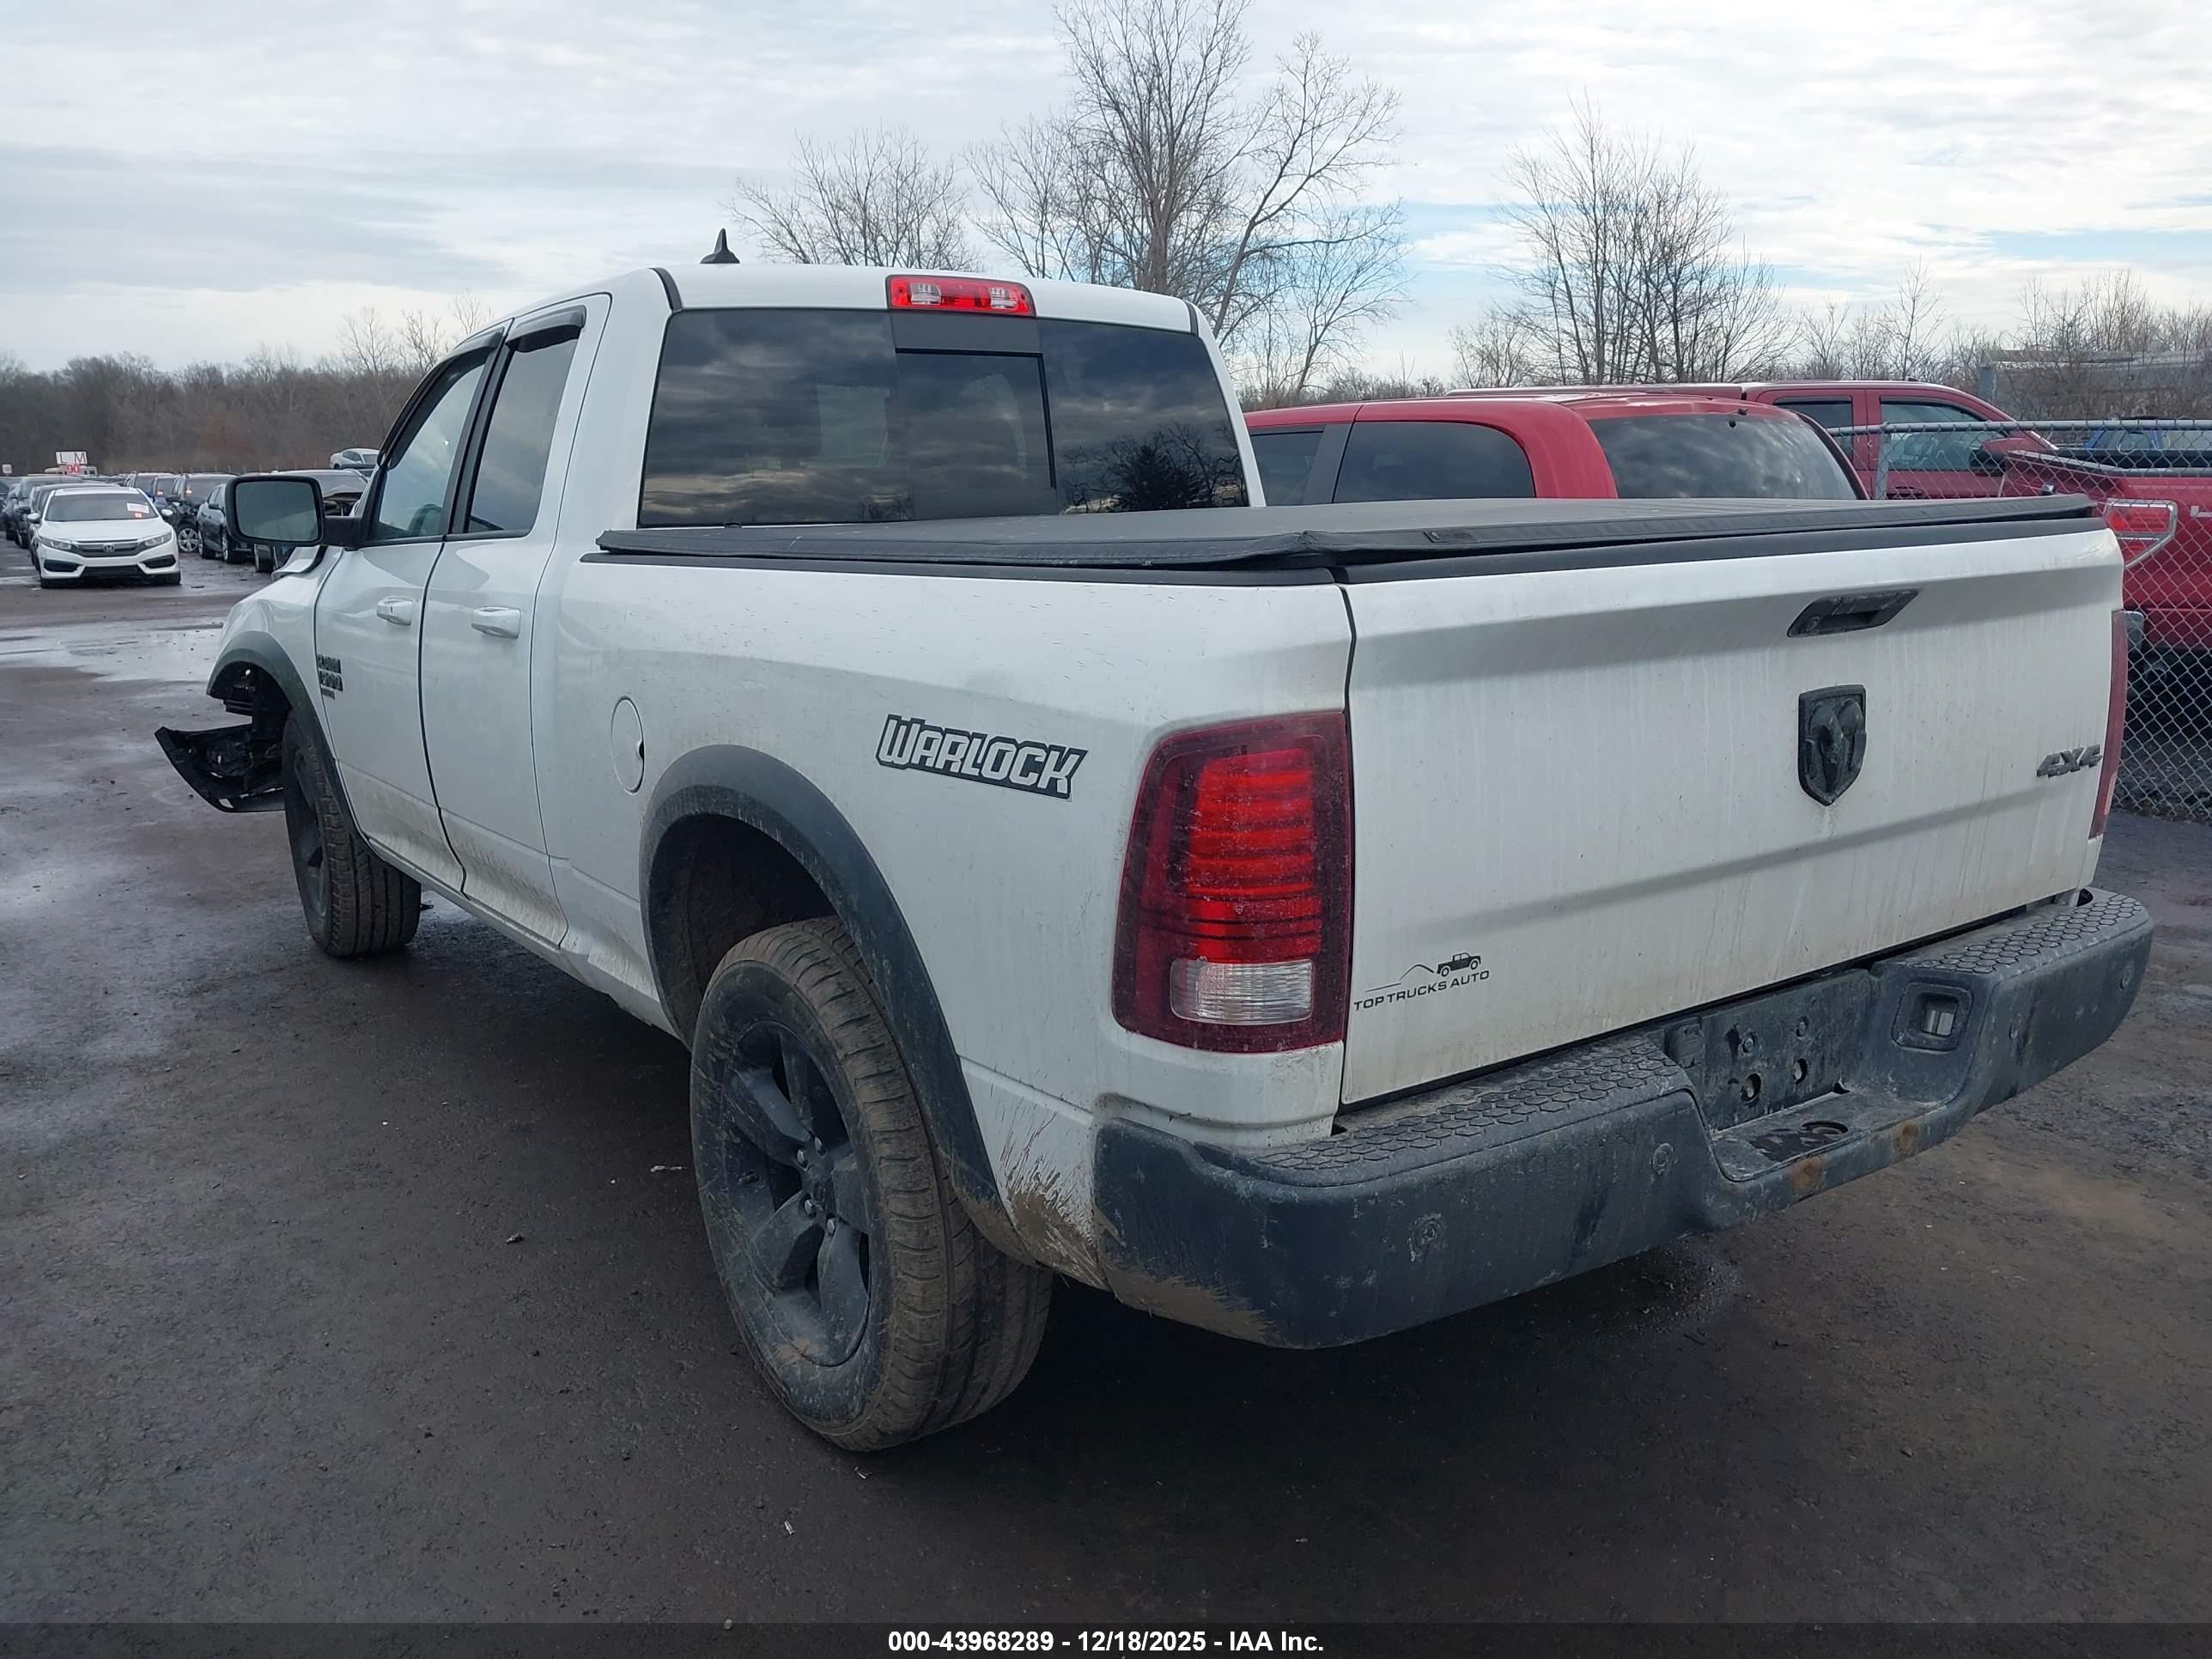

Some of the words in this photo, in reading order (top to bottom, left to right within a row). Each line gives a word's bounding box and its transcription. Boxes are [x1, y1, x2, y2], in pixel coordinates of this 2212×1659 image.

[875, 714, 1089, 799] WARLOCK
[1353, 996, 1384, 1011] TOP
[1387, 981, 1447, 1003] TRUCKS
[1449, 970, 1490, 988] AUTO
